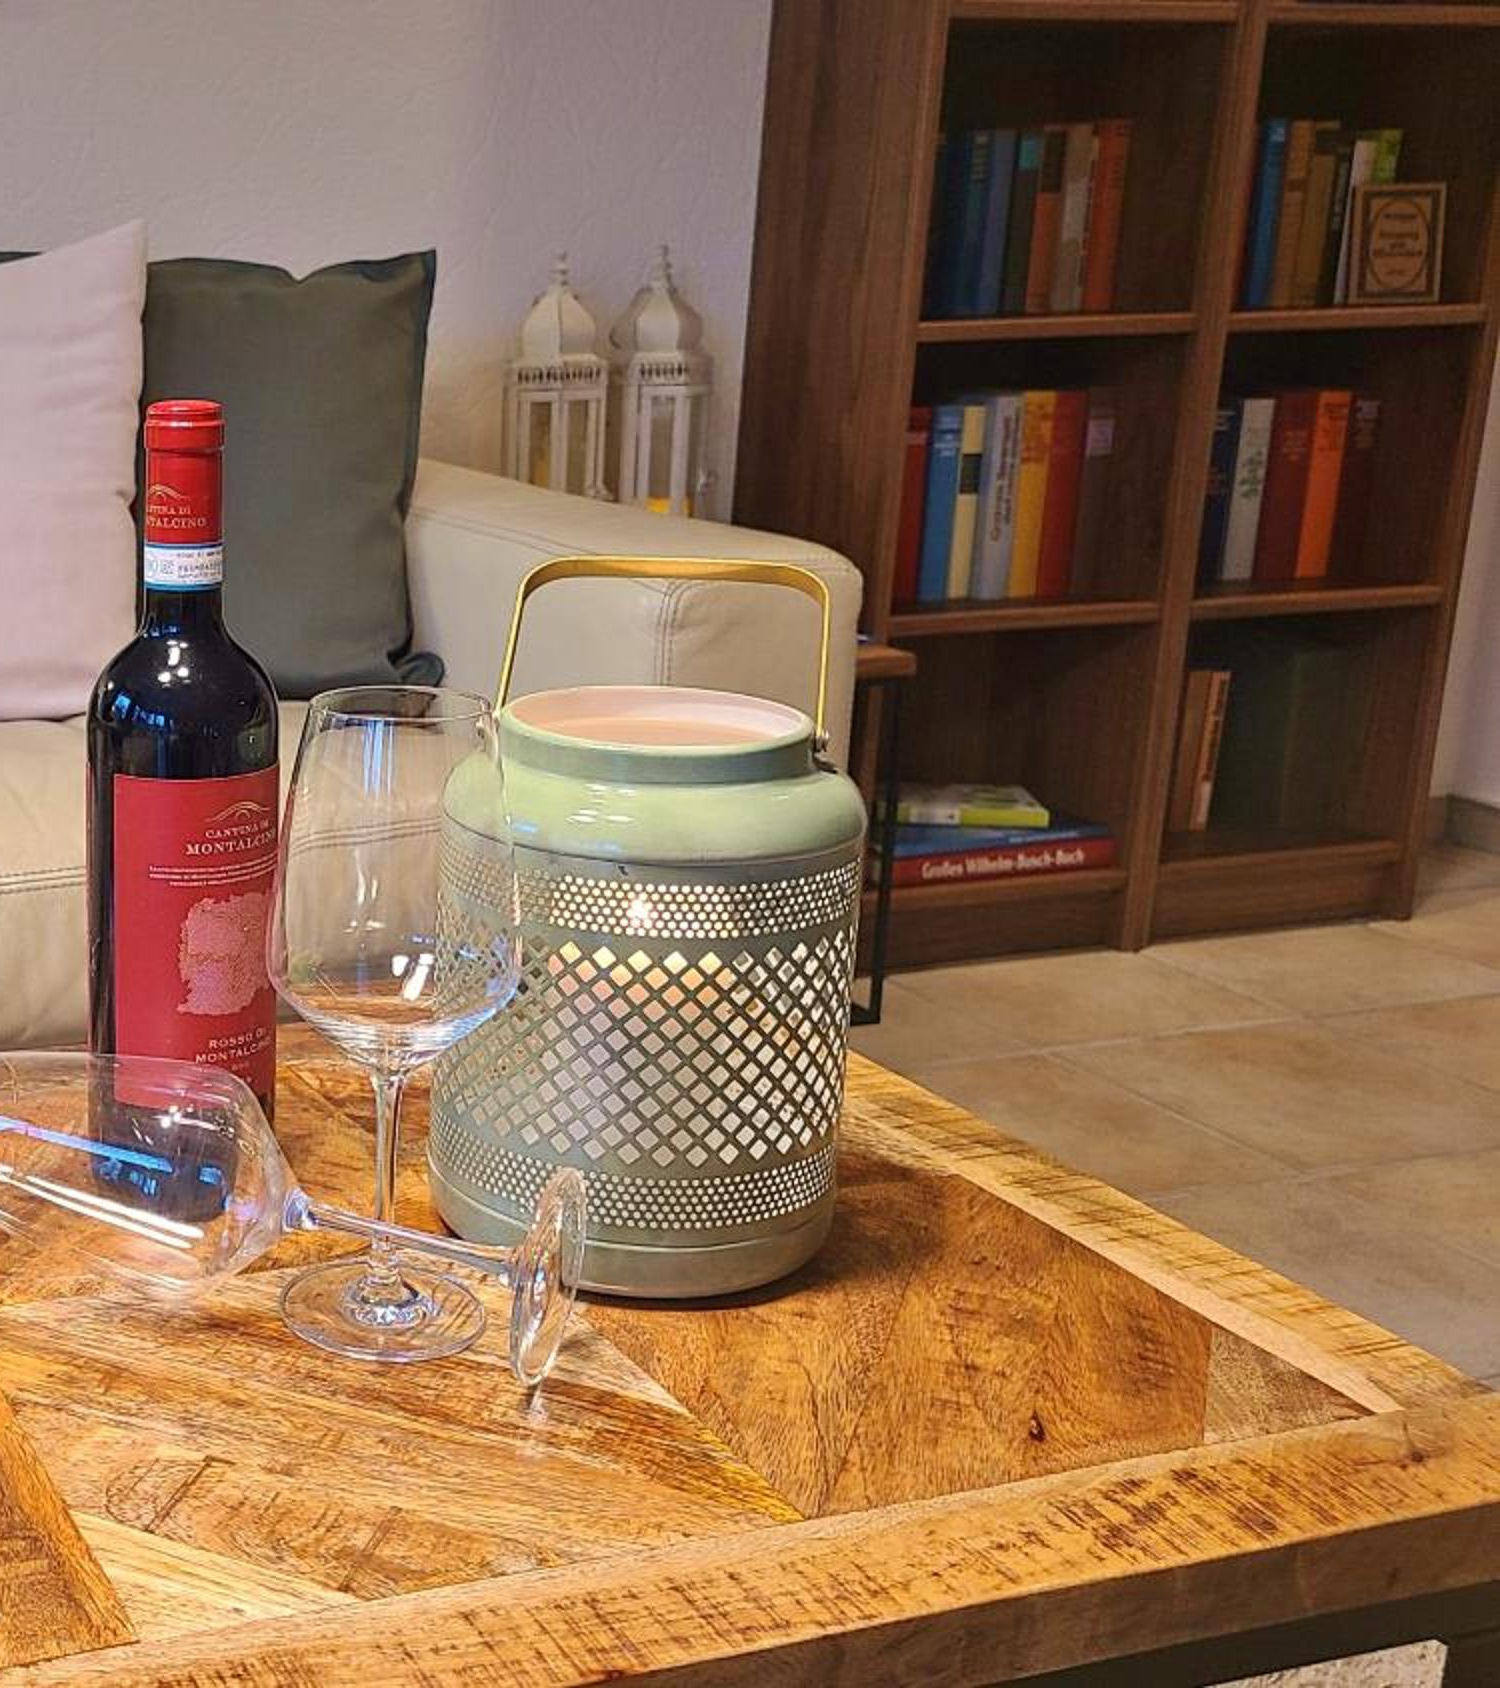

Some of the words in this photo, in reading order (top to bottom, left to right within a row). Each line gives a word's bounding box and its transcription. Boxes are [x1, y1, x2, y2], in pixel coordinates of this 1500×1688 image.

[147, 517, 206, 529] TALCINO
[205, 823, 258, 839] CANTINA
[186, 829, 276, 855] MONTALCIN
[209, 1033, 253, 1048] ROSSO
[195, 1036, 271, 1063] MONTALC
